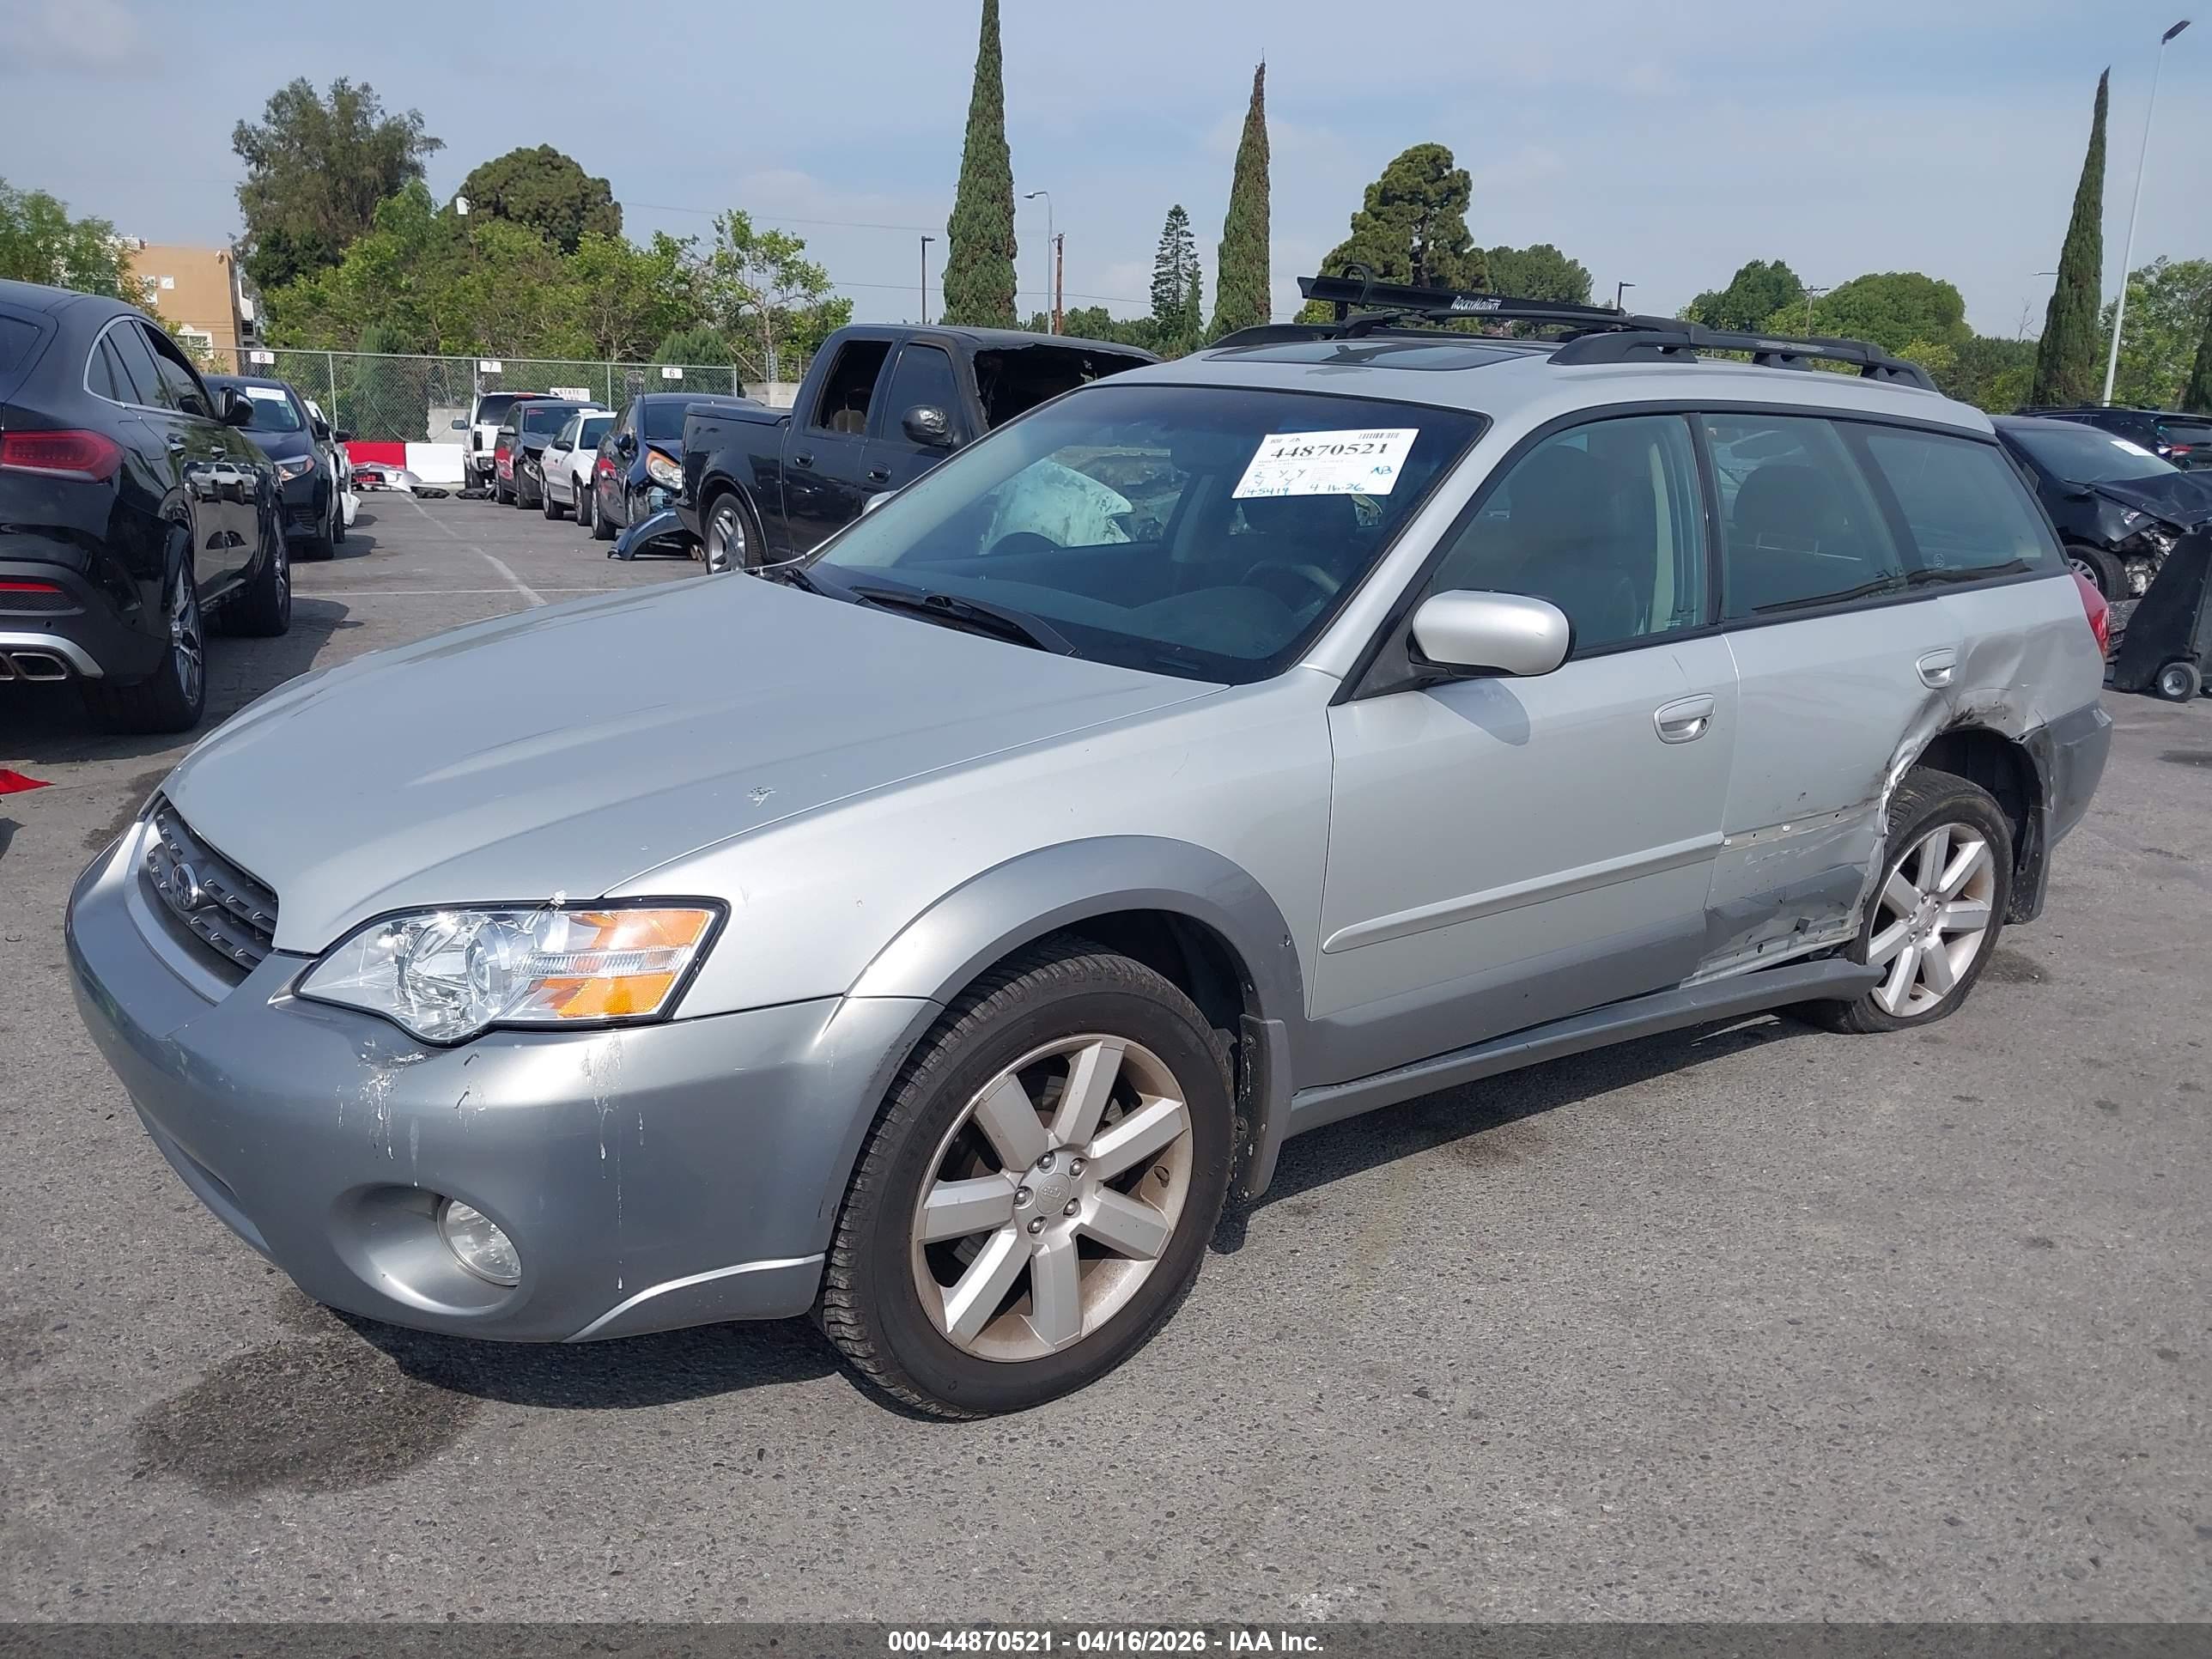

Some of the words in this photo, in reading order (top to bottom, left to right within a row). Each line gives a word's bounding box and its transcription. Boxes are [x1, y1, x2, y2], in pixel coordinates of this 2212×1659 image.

[259, 353, 265, 362] 8
[488, 362, 494, 371] 7
[670, 368, 675, 377] 6
[1270, 442, 1389, 459] 44870521
